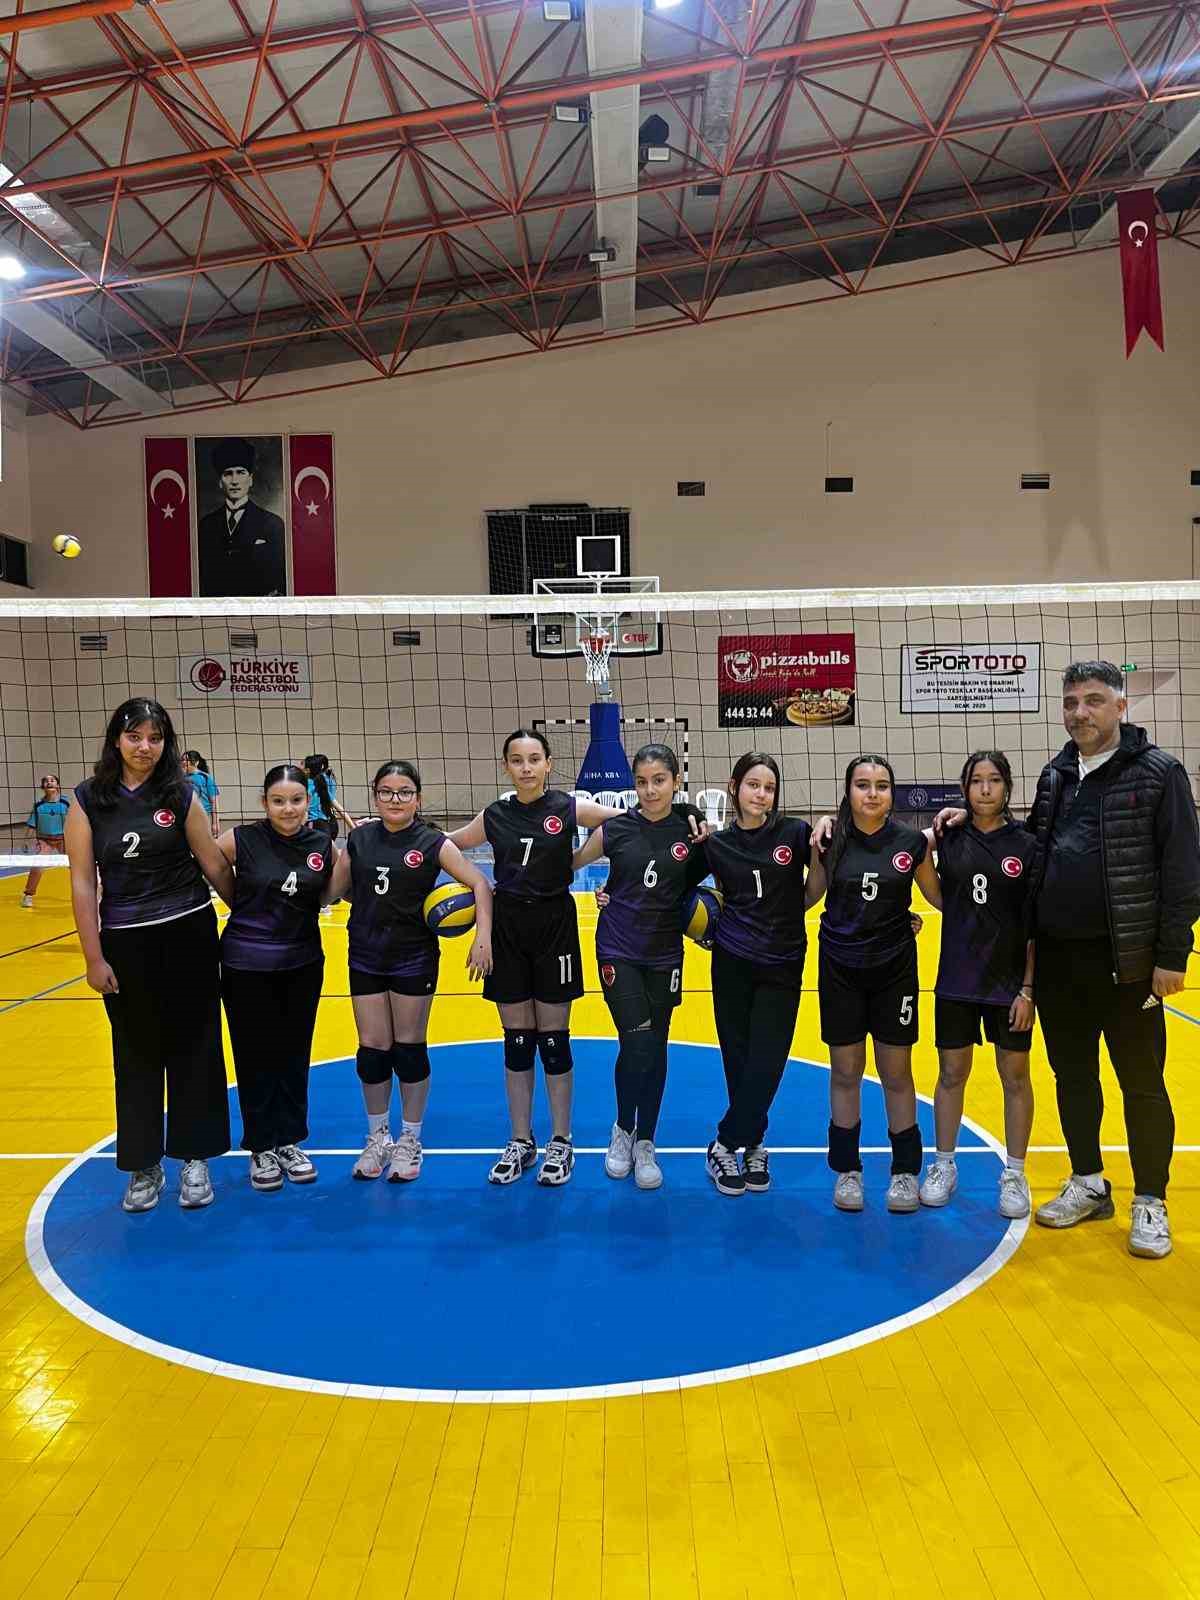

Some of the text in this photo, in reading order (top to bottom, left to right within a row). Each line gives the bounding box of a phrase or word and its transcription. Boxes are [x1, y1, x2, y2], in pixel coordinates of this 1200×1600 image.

[231, 657, 299, 674] TÜRKİYE
[760, 651, 850, 668] pizzabulls
[915, 655, 1026, 670] SPORTOTO
[230, 674, 299, 684] BASKETBOL
[230, 684, 299, 692] FEDERASYONU
[725, 707, 773, 718] 444 32 44
[122, 832, 140, 858] 2
[519, 837, 534, 867] 7
[281, 871, 298, 897] 4
[374, 866, 391, 895] 3
[643, 859, 658, 889] 6
[752, 869, 763, 898] 1
[861, 872, 878, 902] 5
[972, 873, 988, 905] 8
[558, 954, 573, 985] 11
[899, 995, 913, 1026] 5
